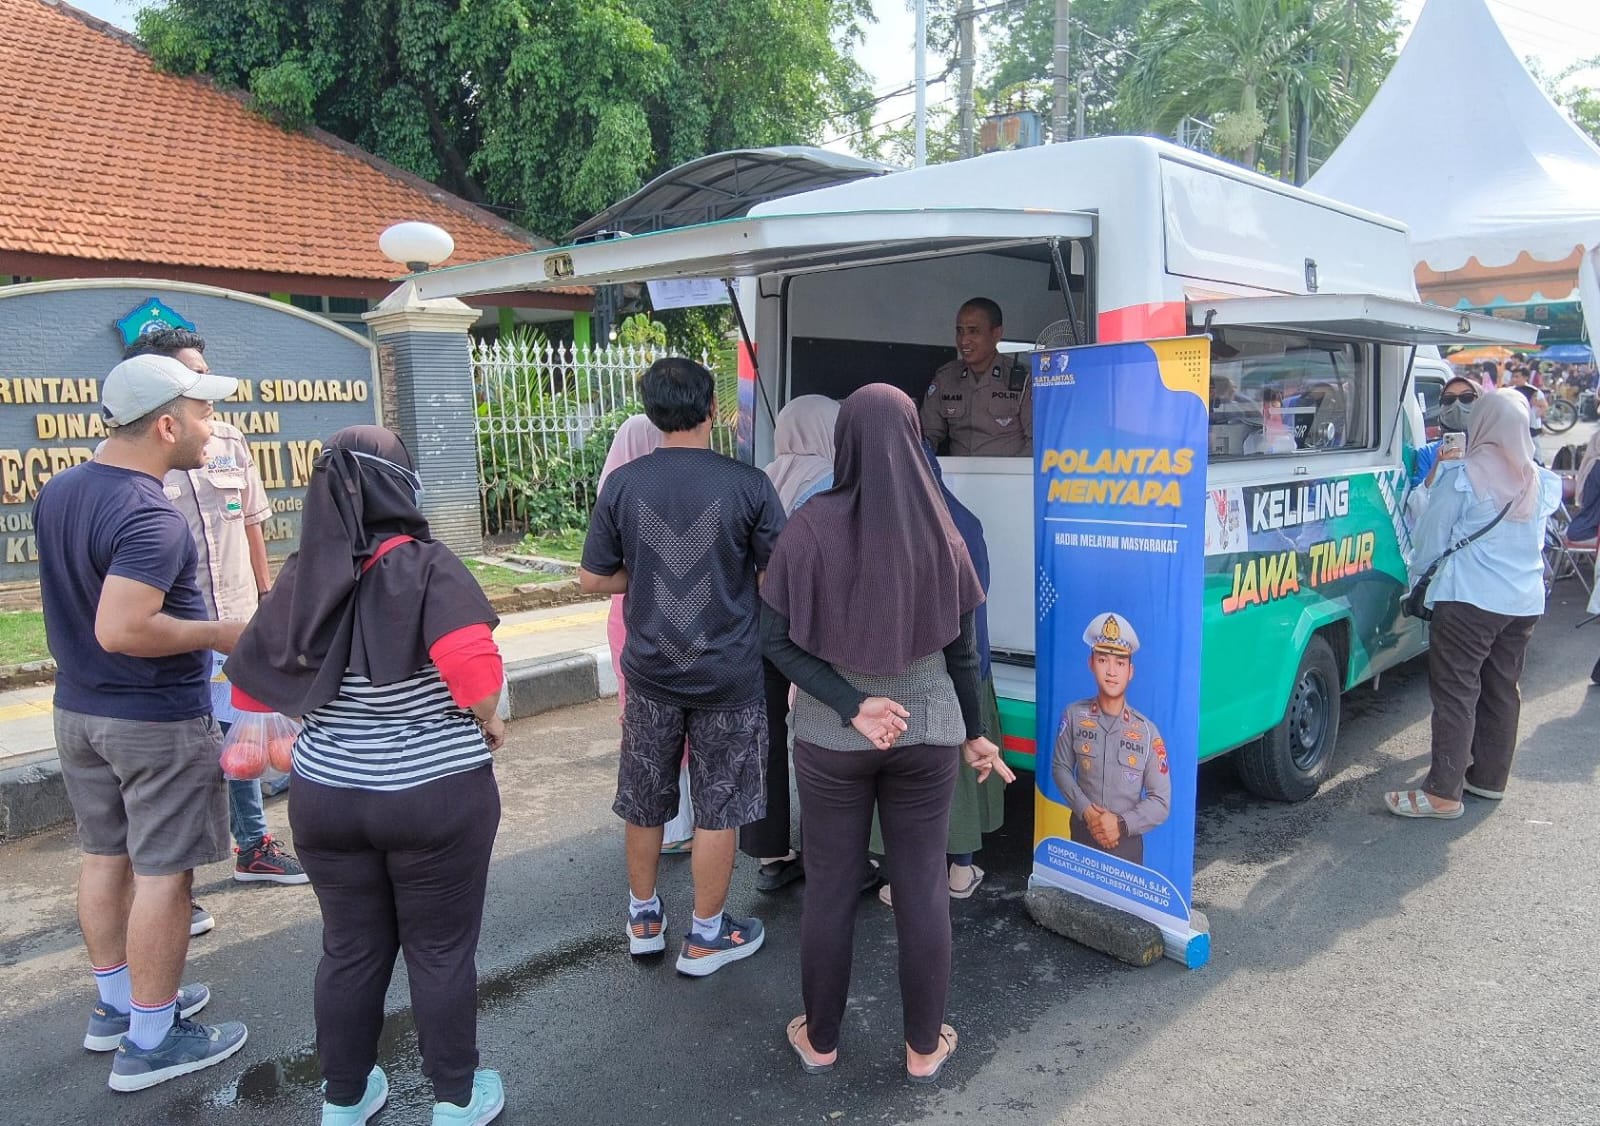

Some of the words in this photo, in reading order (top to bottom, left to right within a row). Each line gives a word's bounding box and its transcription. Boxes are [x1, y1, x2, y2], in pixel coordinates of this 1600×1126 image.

[260, 379, 367, 402] SIDOARJO
[992, 391, 1018, 400] POLRI
[36, 413, 110, 439] DINA
[1042, 448, 1194, 475] POLANTAS
[1047, 479, 1182, 507] MENYAPA
[1252, 480, 1350, 533] KELILING
[1055, 533, 1078, 546] HADIR
[1121, 536, 1179, 554] MASYARAKAT
[1222, 550, 1299, 614] JAWA
[1309, 532, 1375, 587] TIMUR
[1076, 729, 1097, 740] JODI
[1120, 740, 1144, 754] POLRI
[1049, 856, 1096, 879] KASATLANTAS
[1096, 874, 1131, 894] POLRESTA
[1132, 887, 1170, 907] SIDOARJO
[1081, 856, 1099, 869] JODI
[1100, 863, 1148, 888] INDRAWAN,
[1149, 881, 1171, 896] S.I.K.
